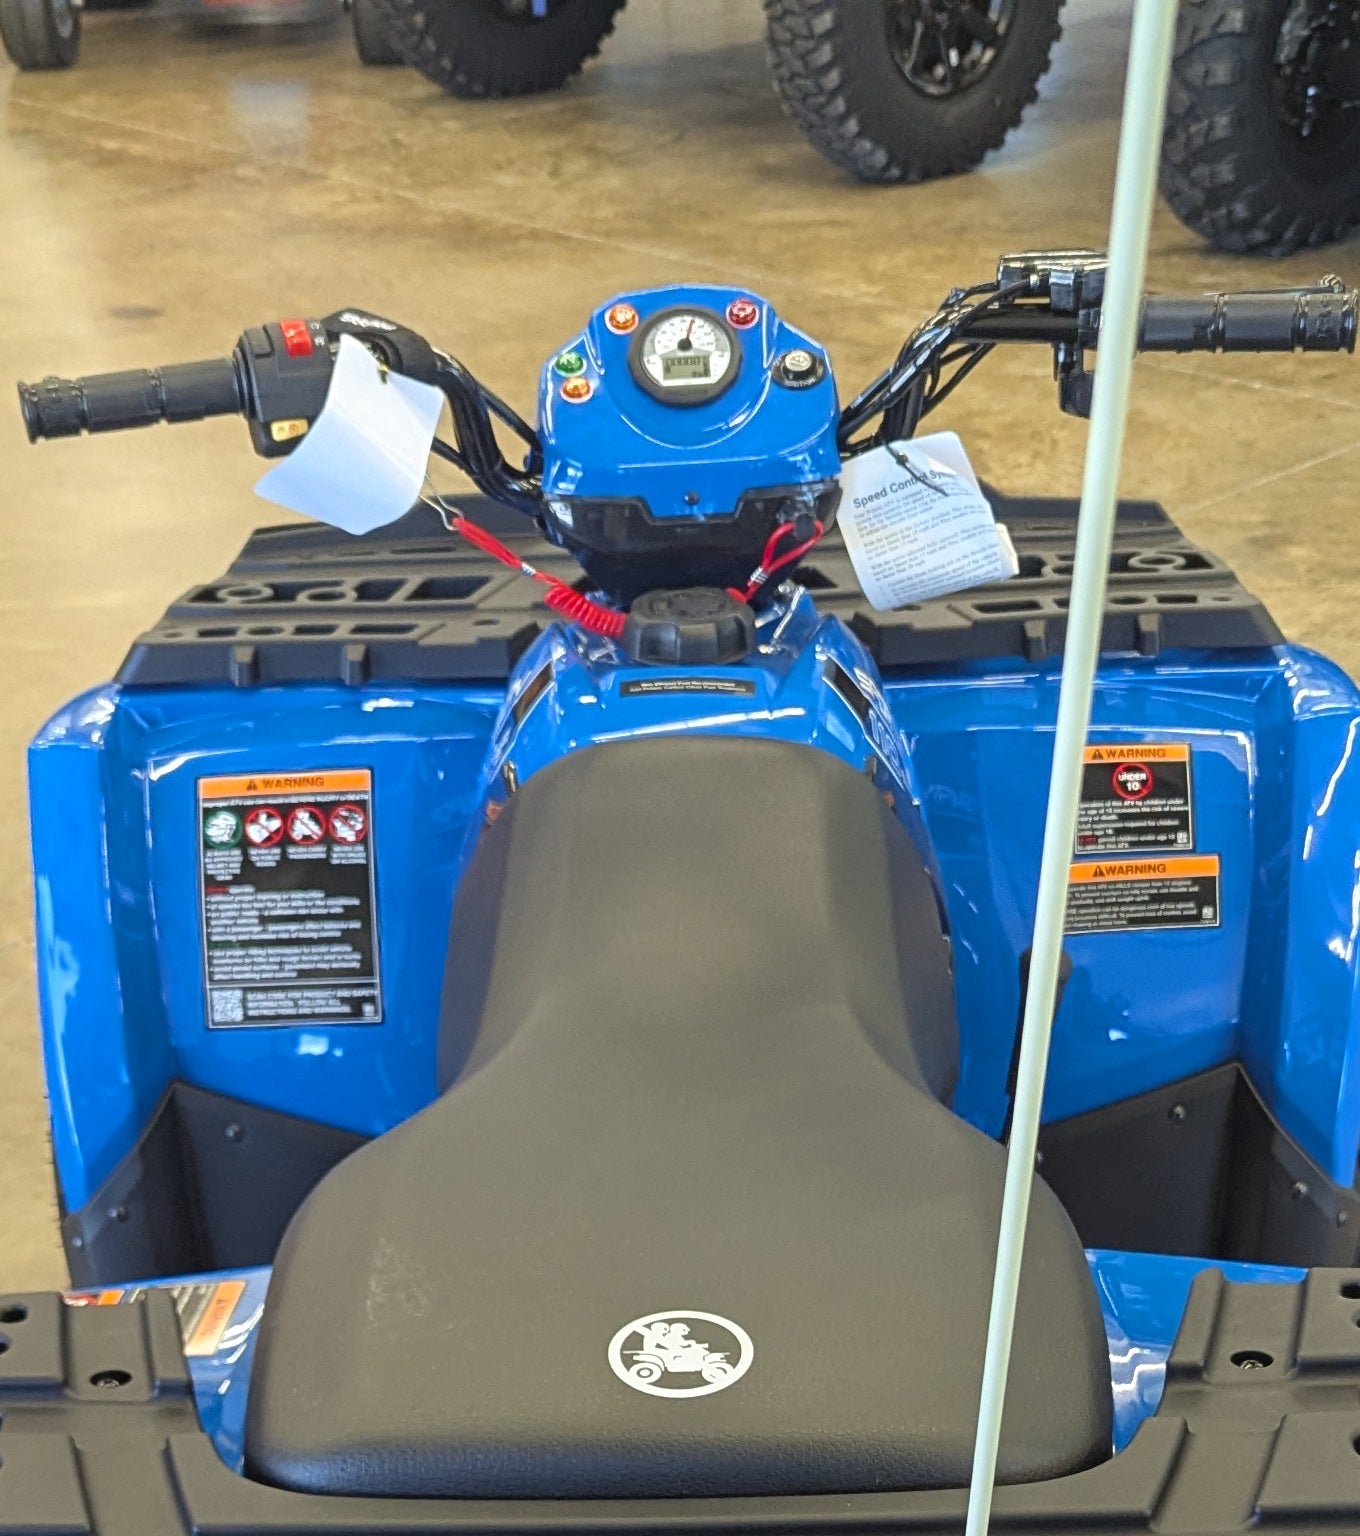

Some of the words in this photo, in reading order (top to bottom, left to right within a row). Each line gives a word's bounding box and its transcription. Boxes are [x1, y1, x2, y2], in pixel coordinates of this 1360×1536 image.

[852, 486, 887, 508] Speed
[1105, 748, 1166, 759] WARNING
[1118, 772, 1147, 781] UNDER
[262, 777, 325, 789] WARNING
[1126, 781, 1141, 791] 10
[1104, 863, 1167, 876] WARNING
